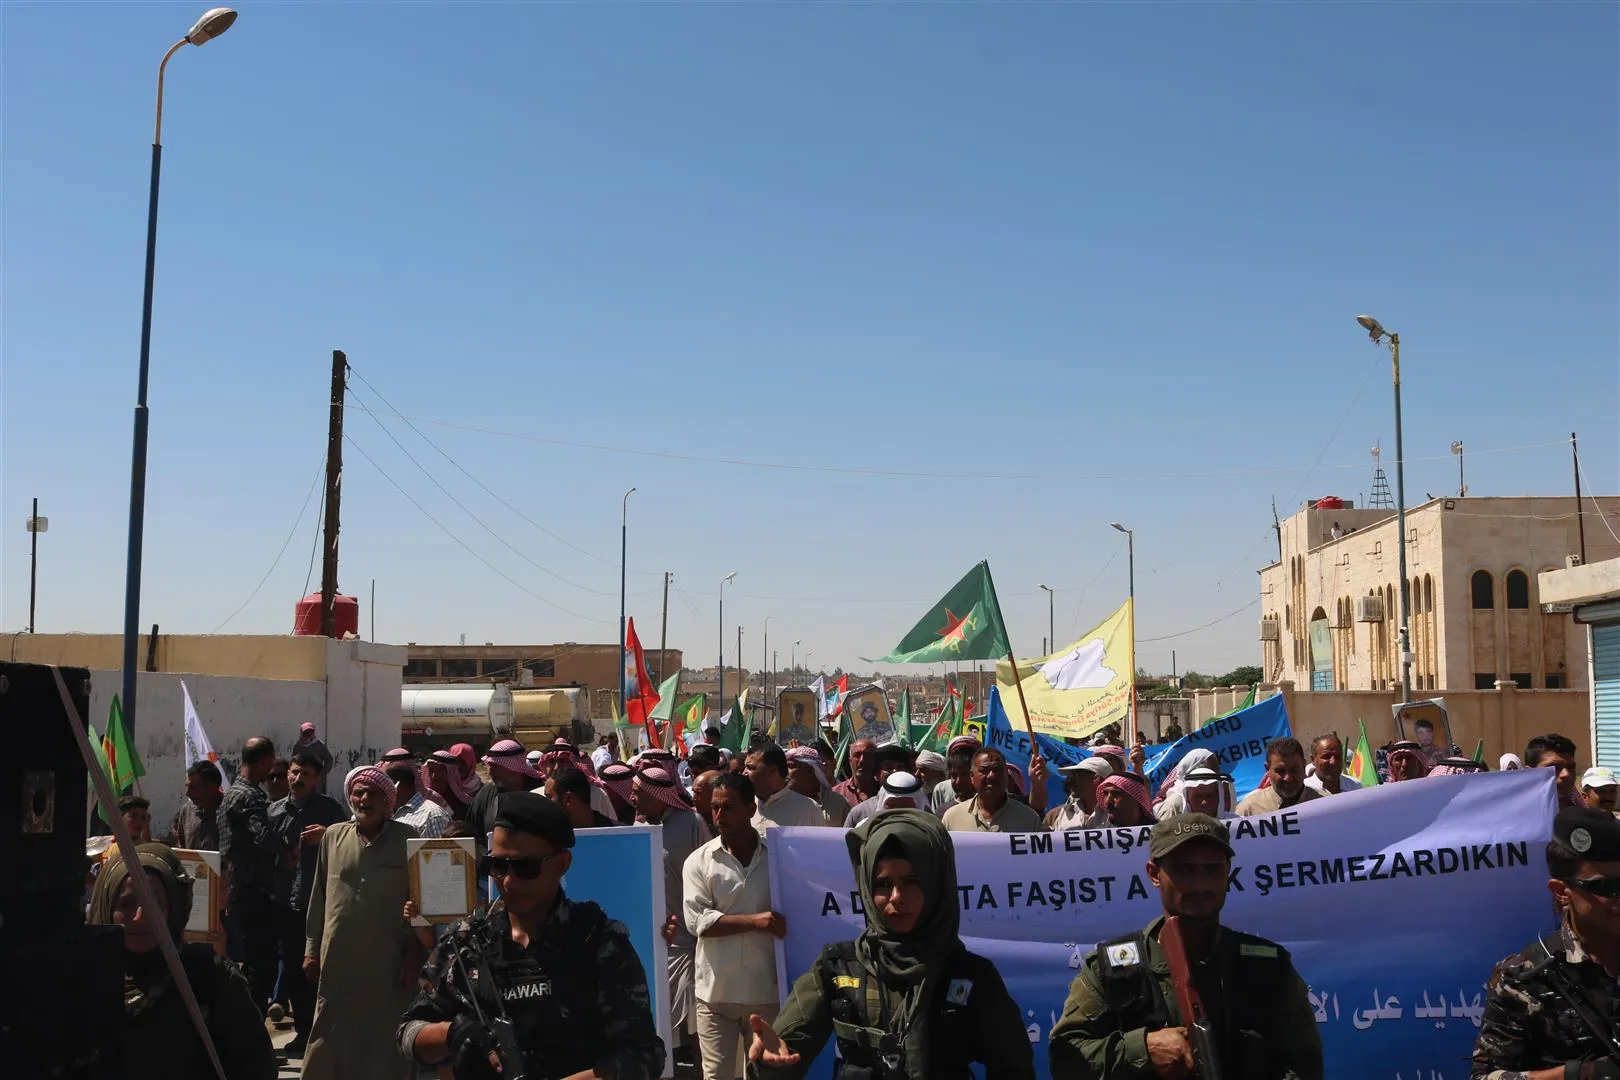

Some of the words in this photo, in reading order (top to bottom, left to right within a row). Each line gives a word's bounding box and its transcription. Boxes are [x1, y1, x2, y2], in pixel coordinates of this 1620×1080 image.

[1010, 832, 1052, 855] EM
[1174, 822, 1209, 836] Jeep
[821, 892, 842, 916] A
[1007, 875, 1117, 911] FAŞIST
[1352, 986, 1404, 1031] على
